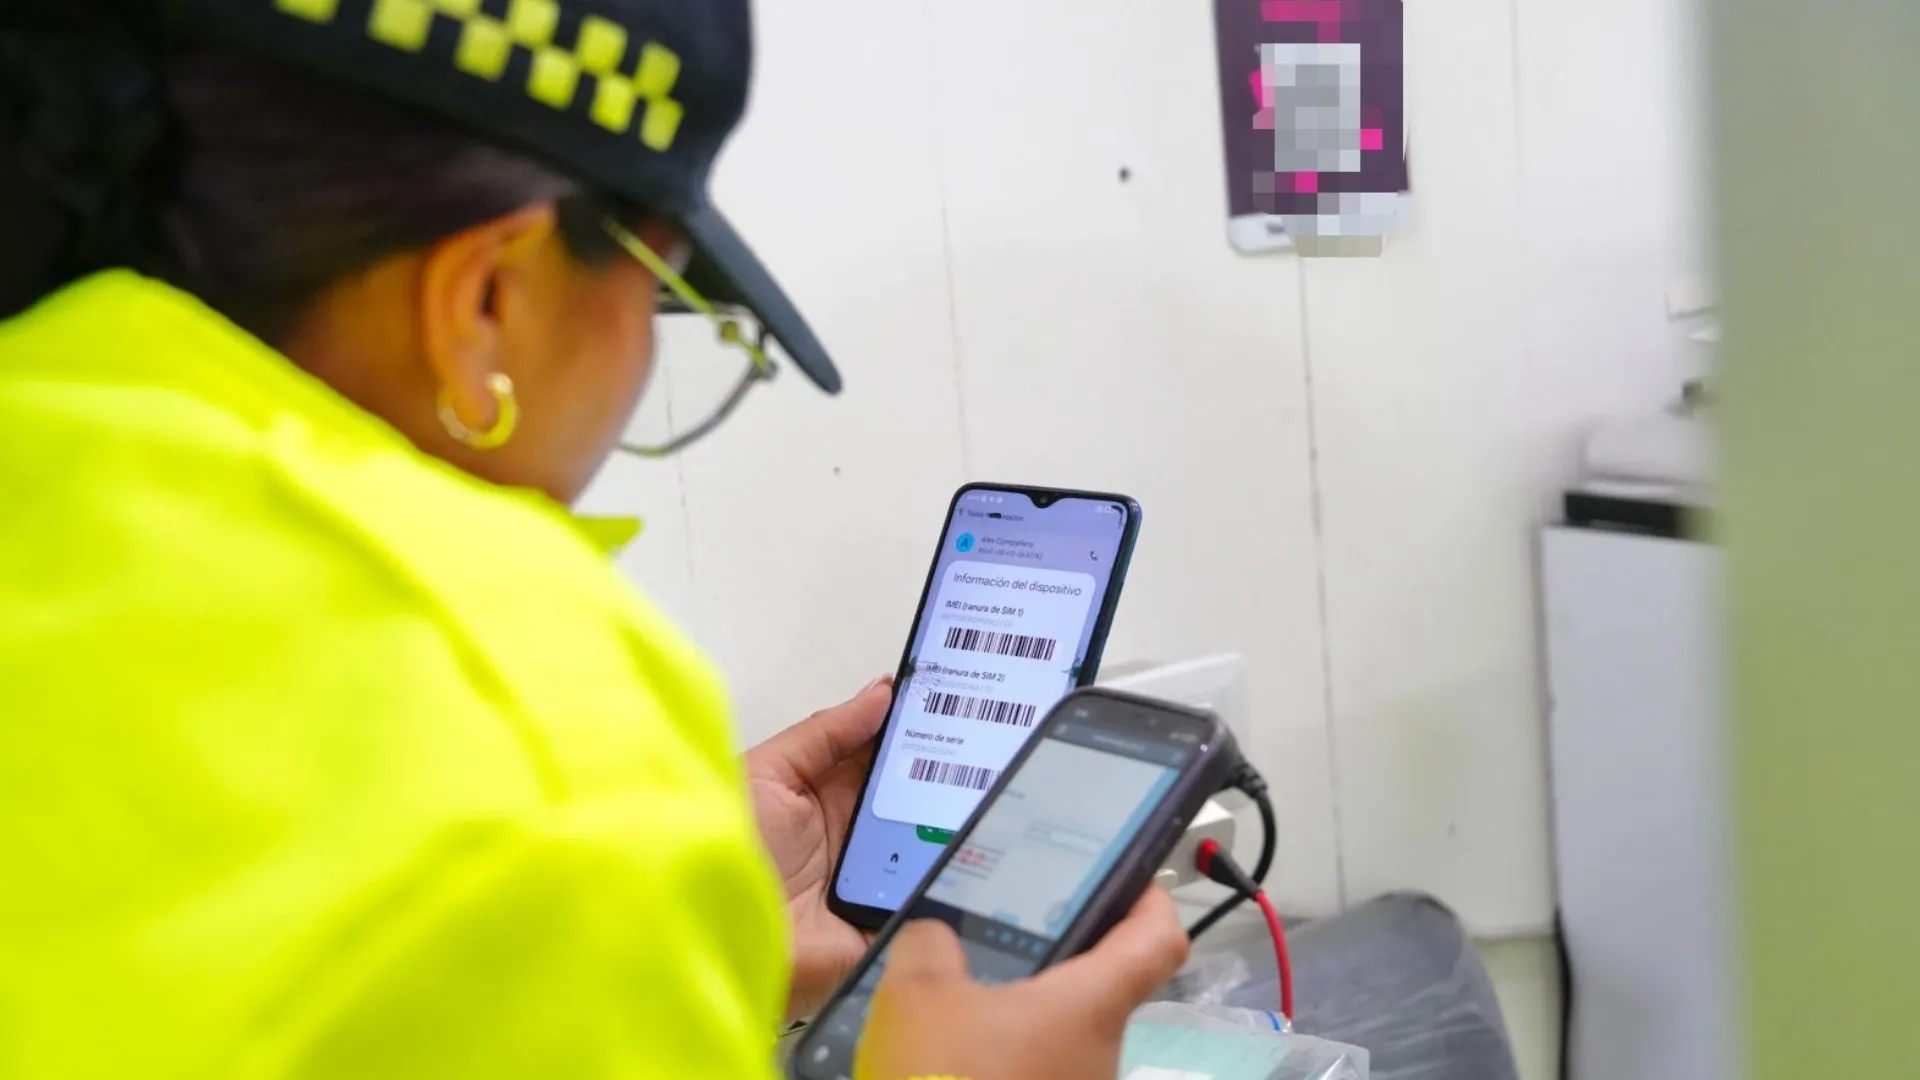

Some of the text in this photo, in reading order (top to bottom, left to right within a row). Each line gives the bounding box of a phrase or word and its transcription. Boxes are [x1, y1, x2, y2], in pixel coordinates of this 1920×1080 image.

[953, 572, 1082, 597] Información del dispositivo
[945, 600, 1024, 617] IMEI (ranura de SIM 1)
[941, 666, 970, 678] (ranura
[970, 670, 981, 679] de
[981, 671, 996, 681] SIM
[997, 673, 1006, 683] 2)
[905, 729, 964, 745] Número de serie
